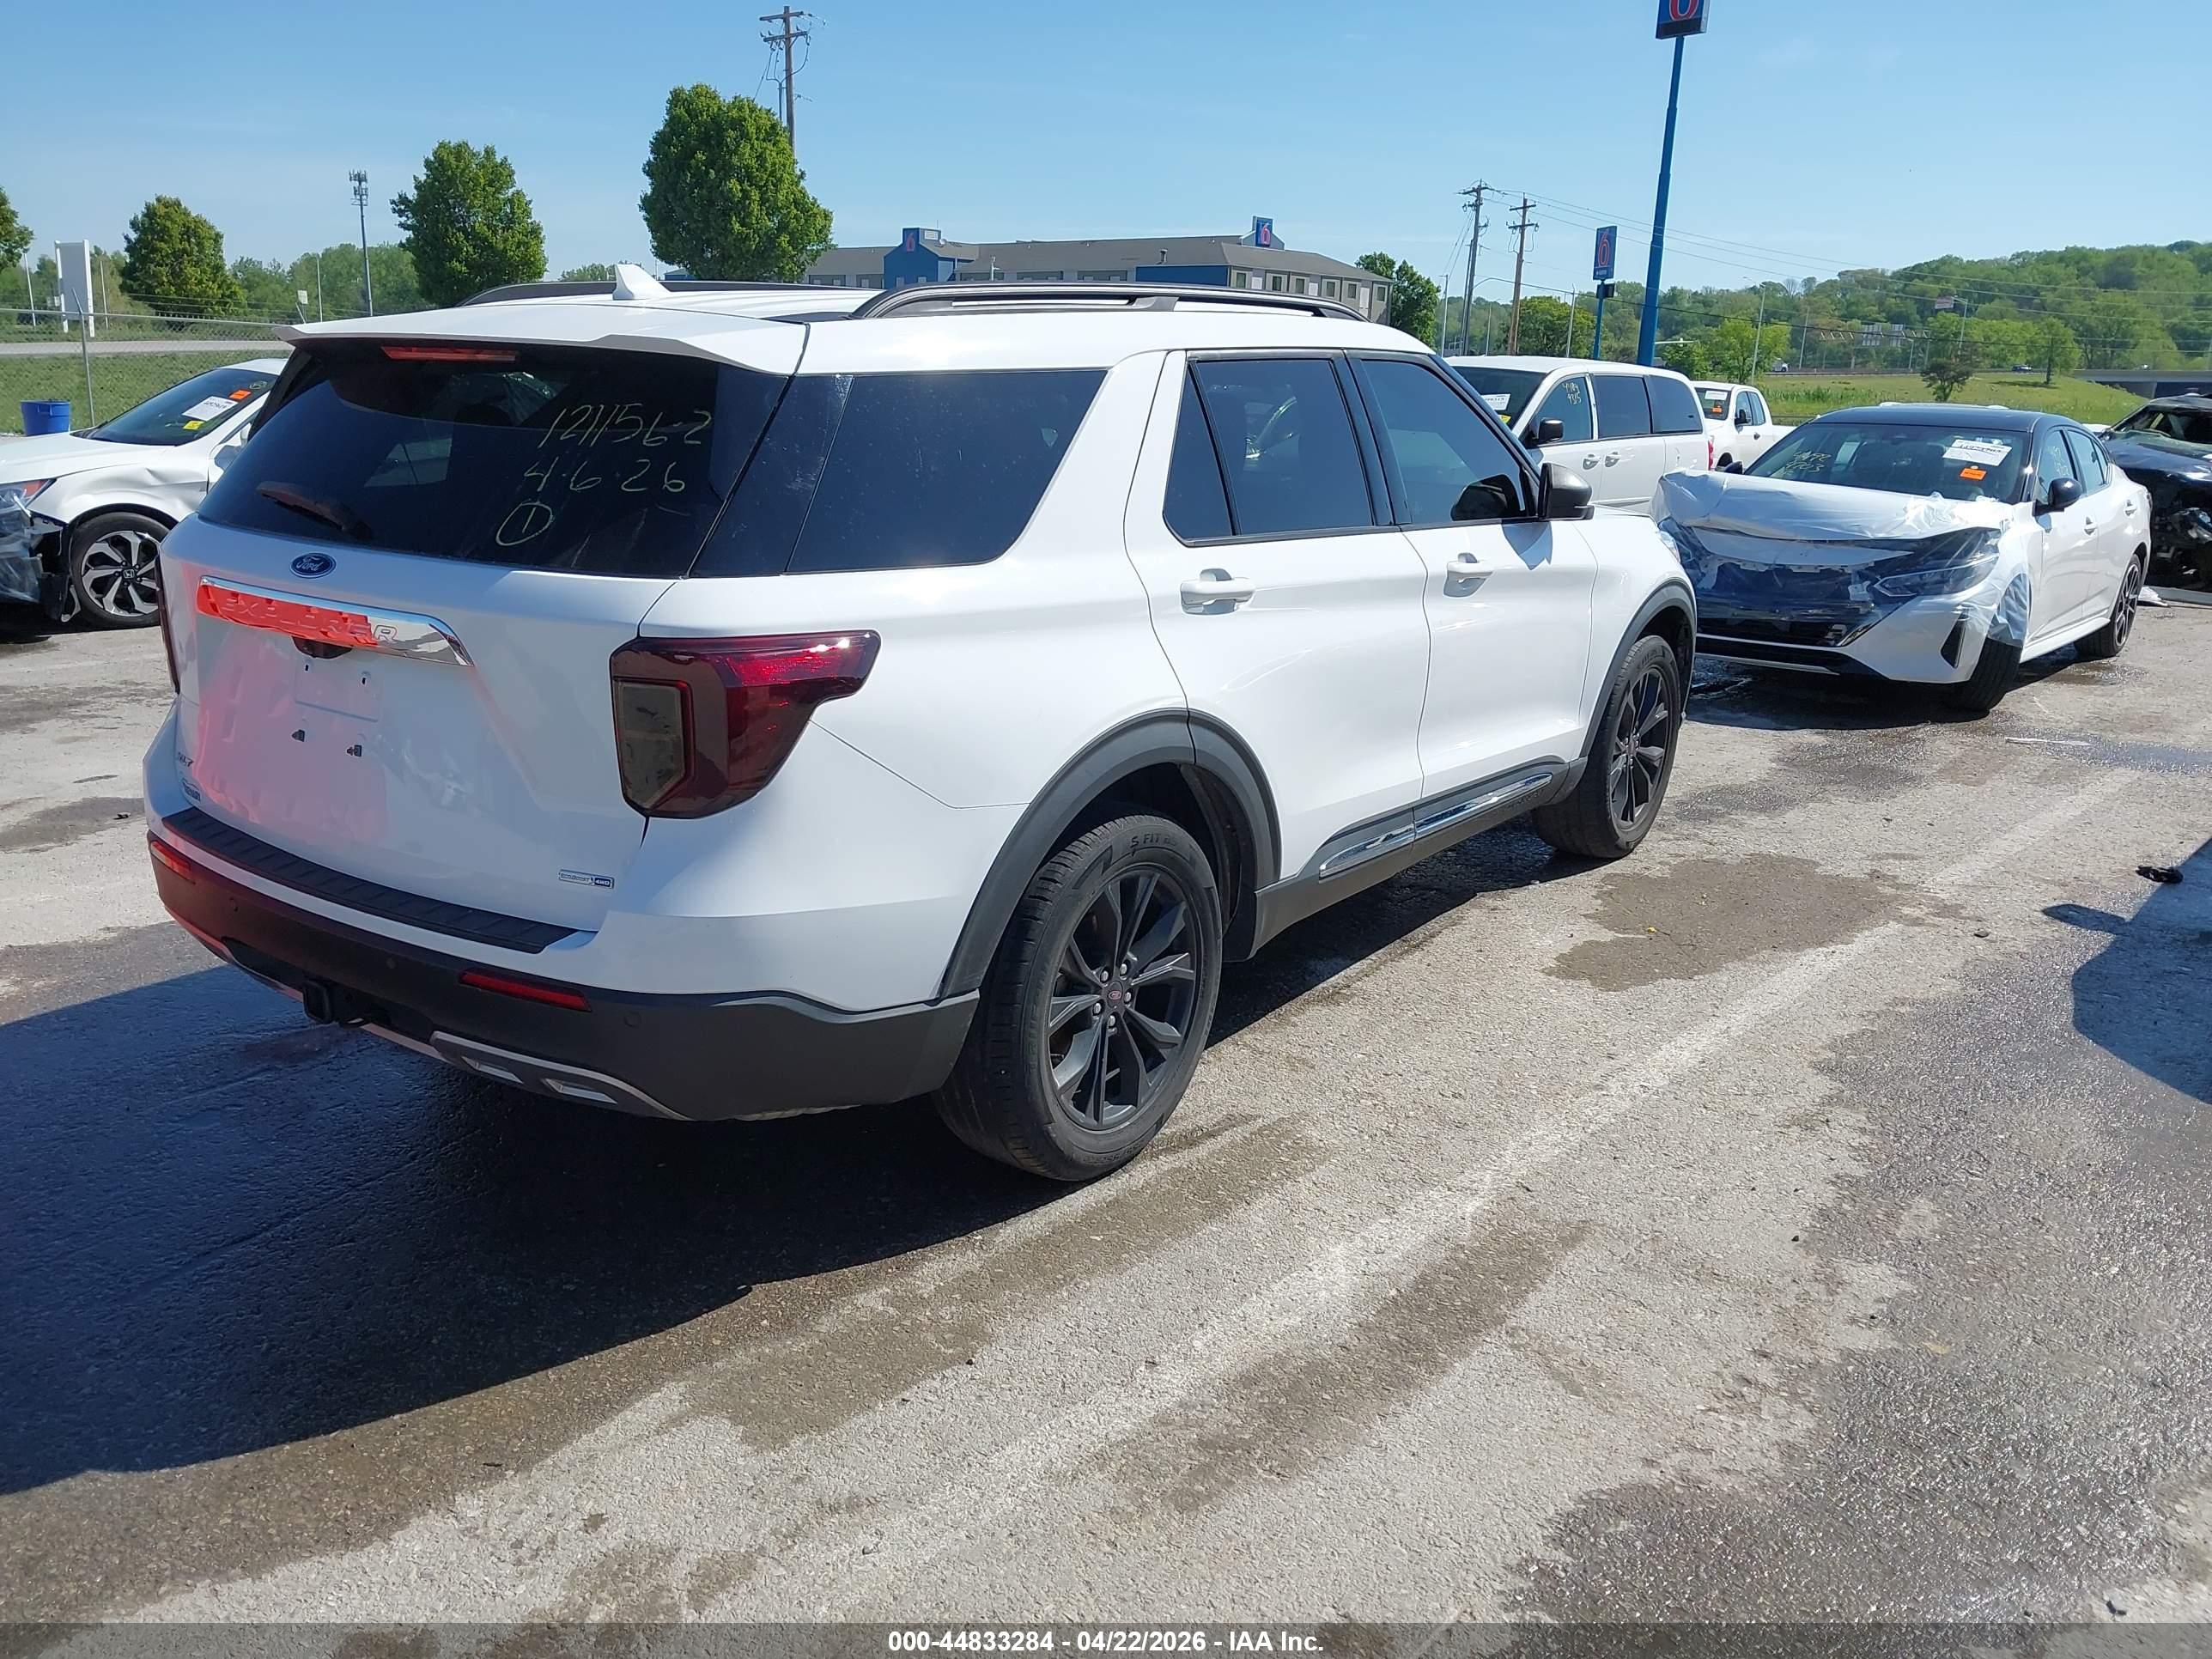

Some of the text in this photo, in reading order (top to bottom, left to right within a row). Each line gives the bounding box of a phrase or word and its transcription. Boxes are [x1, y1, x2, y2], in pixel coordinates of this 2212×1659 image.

[906, 232, 915, 252] 6
[1261, 223, 1271, 245] 6
[1598, 229, 1609, 267] 6
